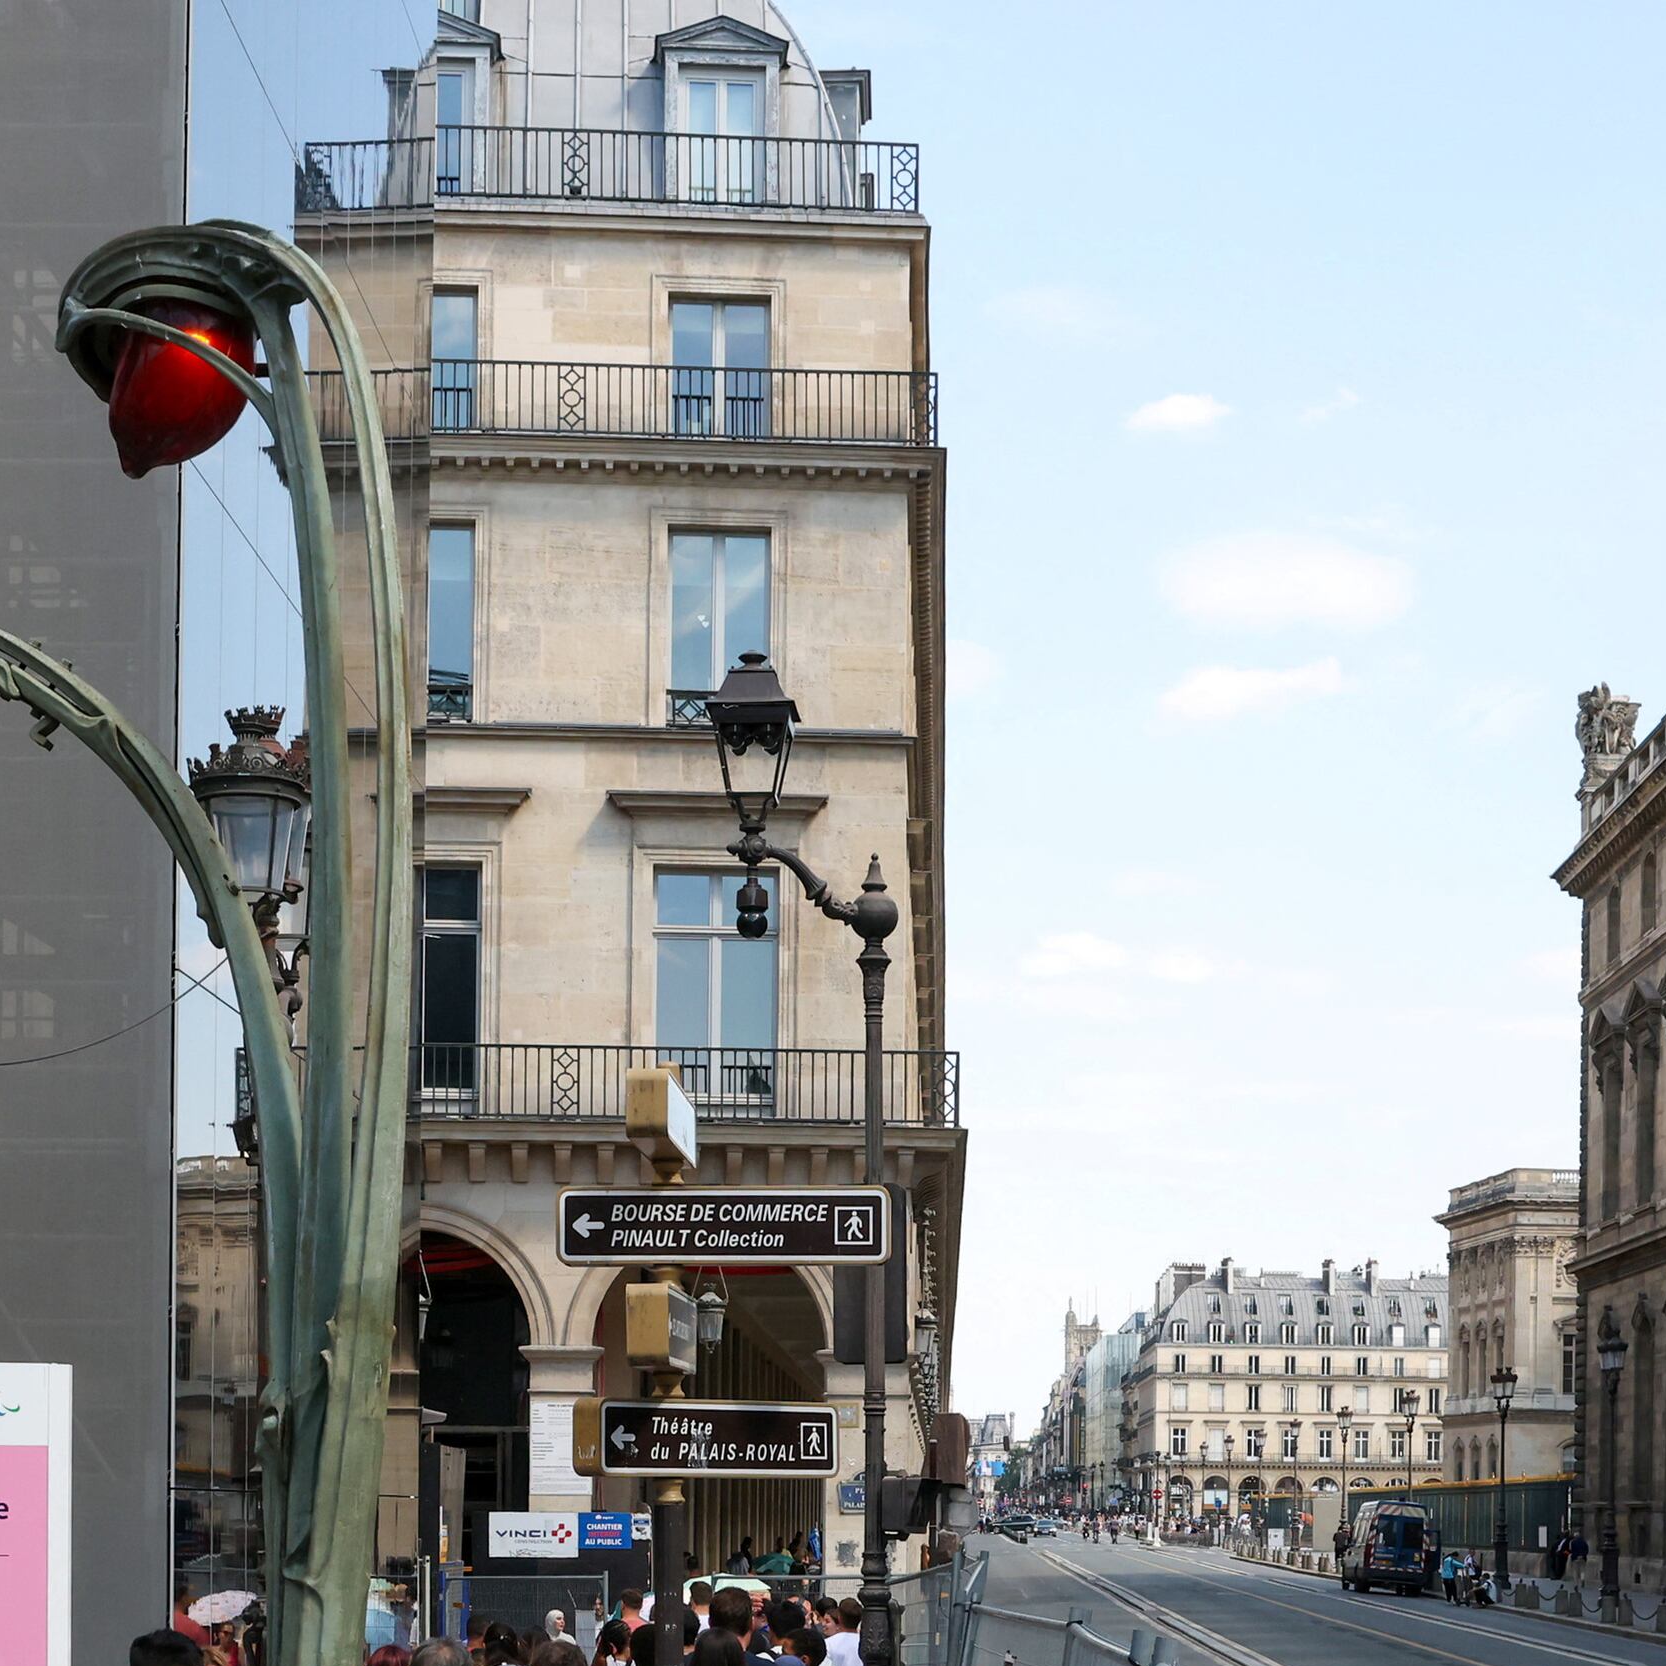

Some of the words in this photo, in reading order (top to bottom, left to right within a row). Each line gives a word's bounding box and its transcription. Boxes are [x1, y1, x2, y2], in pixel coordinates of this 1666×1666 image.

[611, 1204, 687, 1222] BOURSE
[690, 1204, 716, 1222] DE
[718, 1204, 829, 1222] COMMERCE
[611, 1229, 691, 1247] PINAULT
[694, 1229, 784, 1247] Collection
[652, 1416, 713, 1435] Théâtre
[651, 1442, 670, 1460] du
[678, 1442, 796, 1462] PALAIS-ROYAL
[496, 1530, 547, 1538] VINCI
[586, 1523, 623, 1531] CHANTIER
